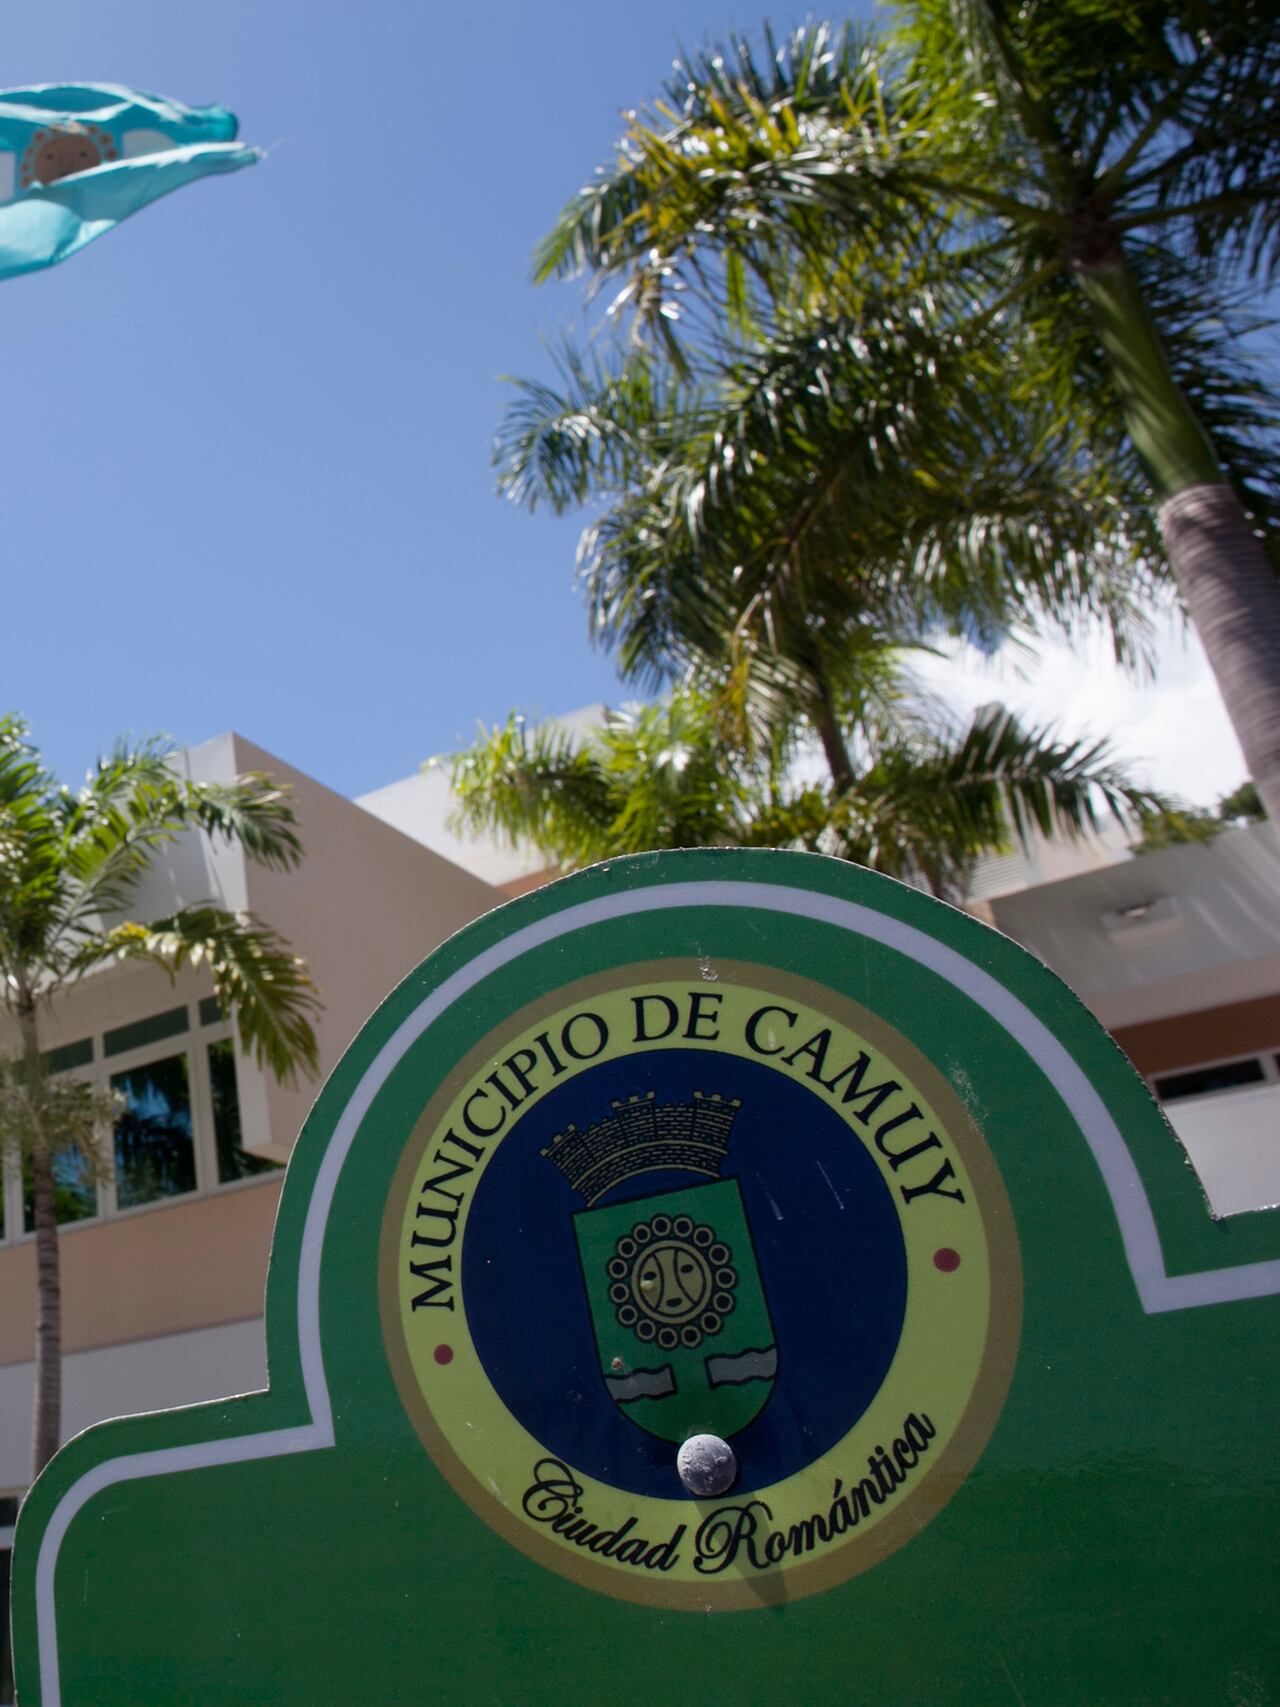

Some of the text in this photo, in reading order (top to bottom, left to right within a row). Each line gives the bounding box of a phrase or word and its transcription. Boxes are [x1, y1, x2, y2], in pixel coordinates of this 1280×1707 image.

[409, 992, 966, 1312] MUNICIPIO DE CAMUY
[521, 1412, 937, 1574] Ciudad Romántica
